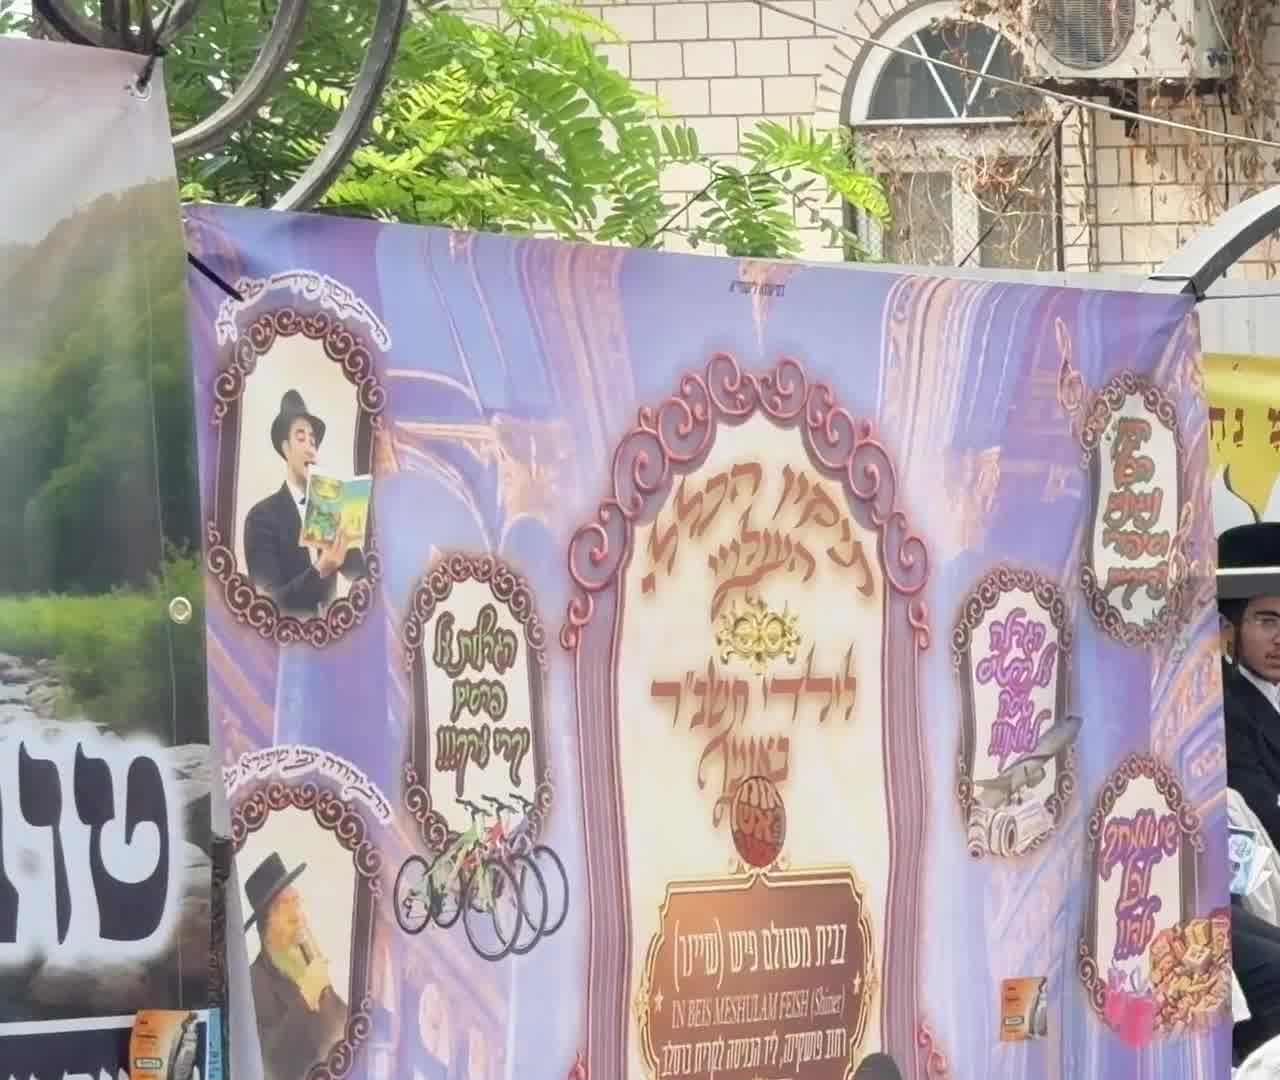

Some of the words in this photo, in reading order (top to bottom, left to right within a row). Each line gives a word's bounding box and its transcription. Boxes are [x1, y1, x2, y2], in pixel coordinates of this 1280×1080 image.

[641, 461, 763, 594] הכללי
[0, 741, 170, 945] טו
[728, 929, 759, 974] פיש
[762, 919, 812, 971] משולם
[815, 923, 848, 967] בבית
[671, 999, 685, 1029] IN
[687, 997, 713, 1028] BEIS
[713, 990, 780, 1026] MESHULAM
[779, 988, 810, 1020] FEISH
[764, 1028, 779, 1065] ליד
[825, 1027, 847, 1060] רחוב
